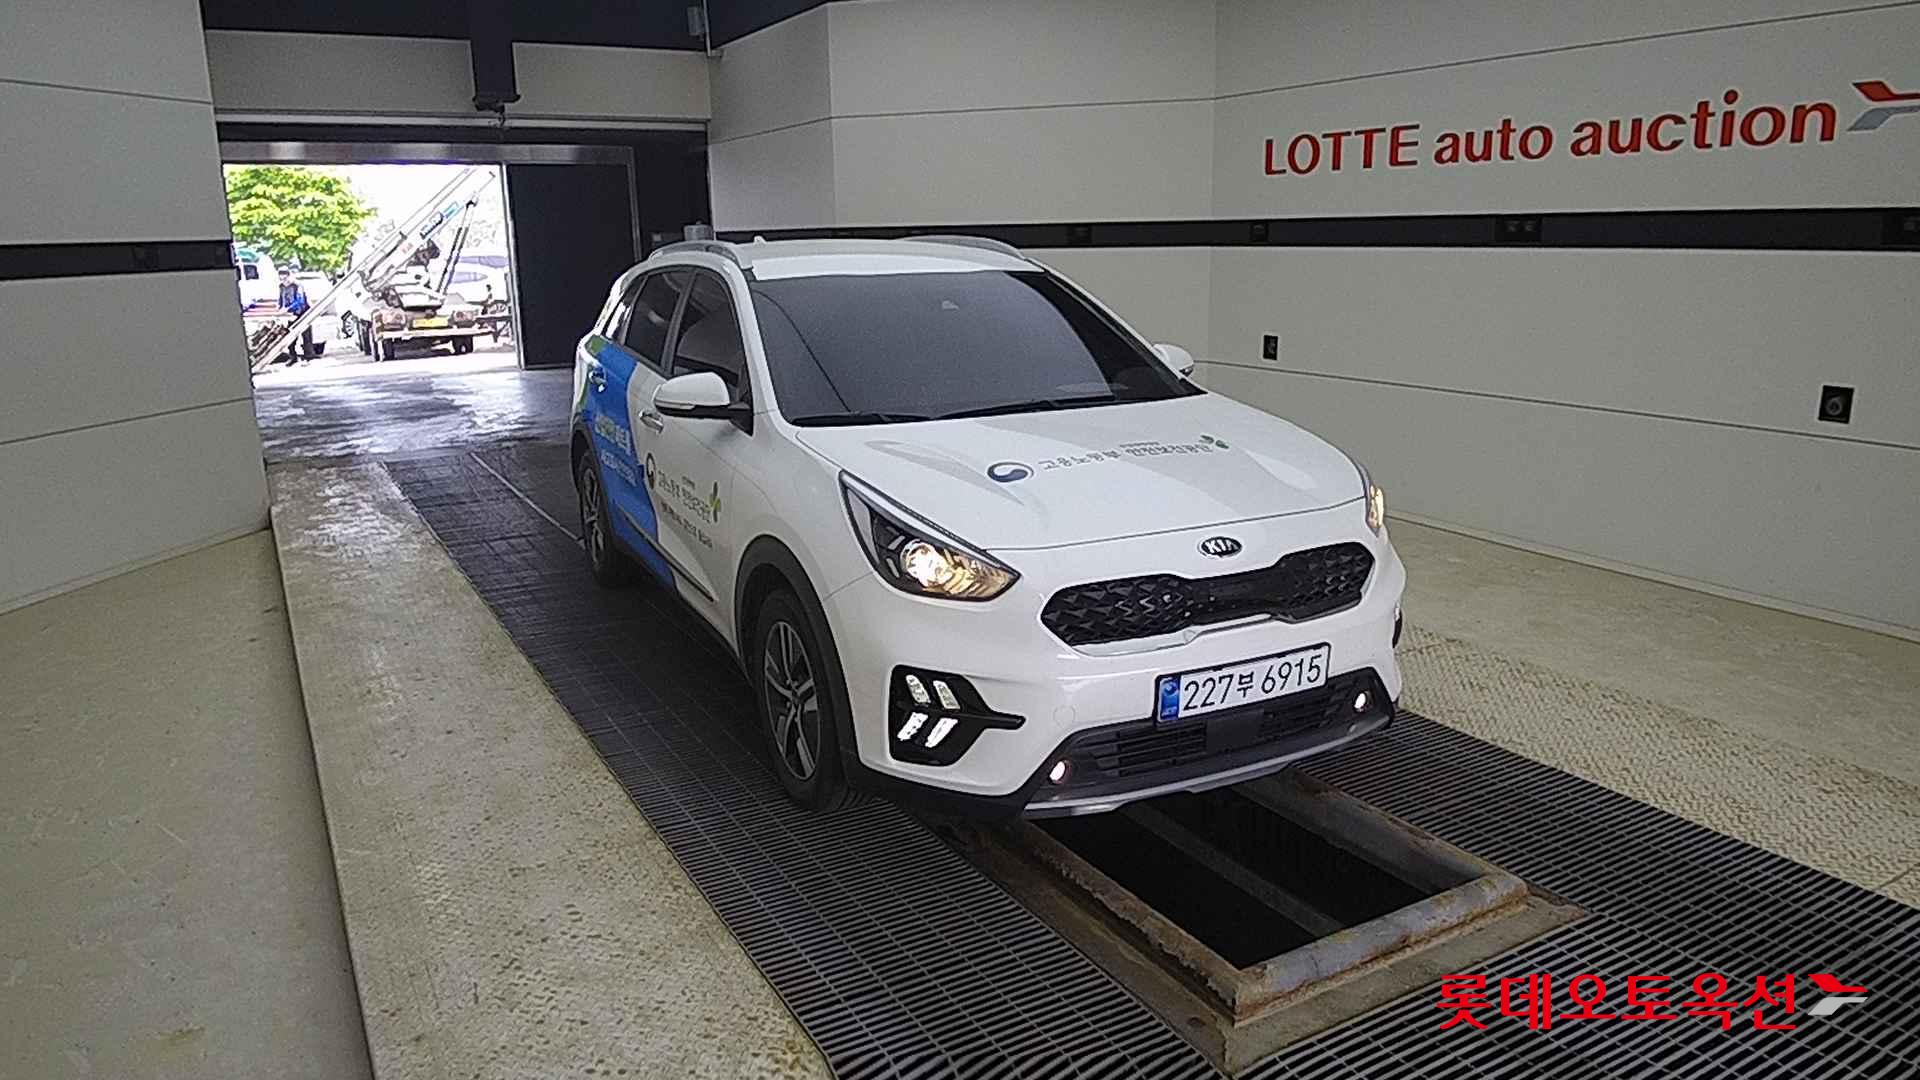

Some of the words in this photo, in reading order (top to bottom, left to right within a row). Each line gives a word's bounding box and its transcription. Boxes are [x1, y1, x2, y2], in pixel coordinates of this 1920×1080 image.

[1264, 124, 1421, 176] LOTTE
[1433, 117, 1553, 166] auto
[1569, 88, 1836, 157] auction
[1203, 537, 1241, 556] KIA
[1183, 671, 1255, 712] 227부
[1261, 654, 1323, 694] 6915
